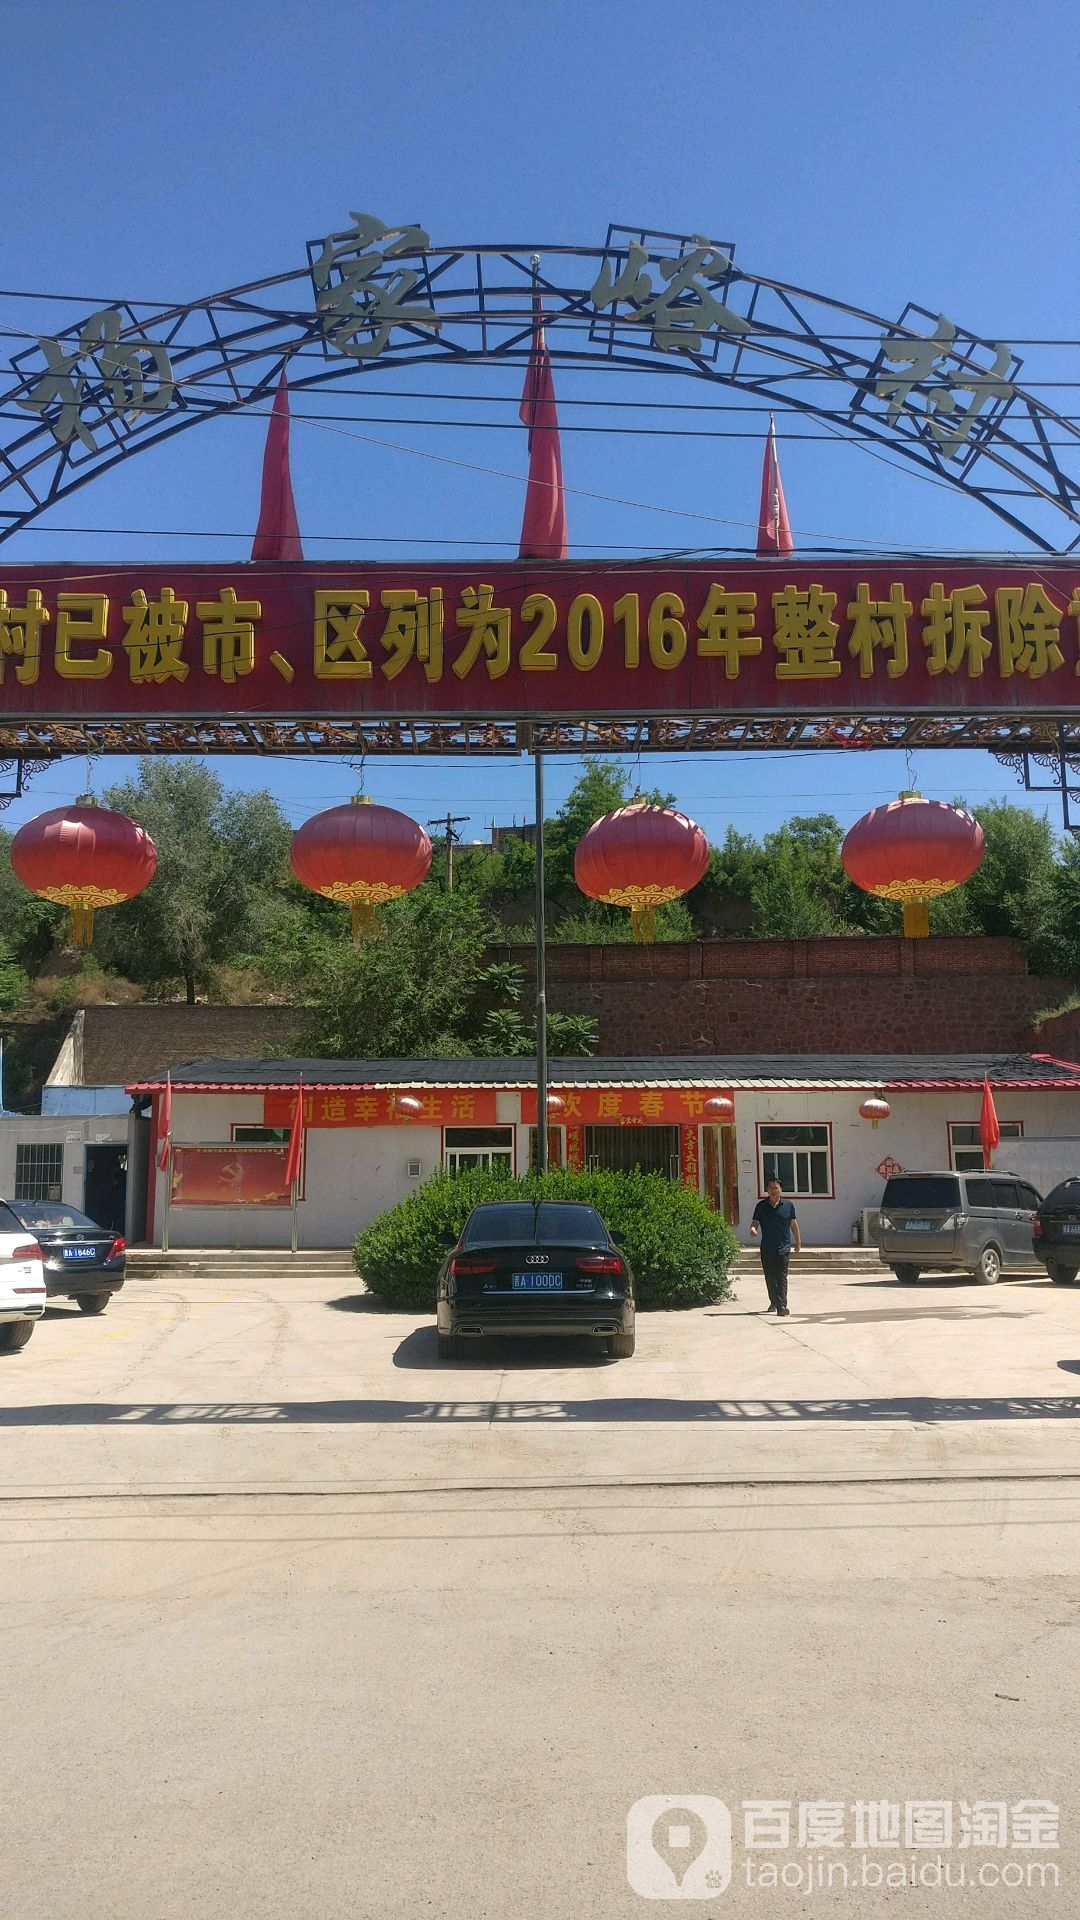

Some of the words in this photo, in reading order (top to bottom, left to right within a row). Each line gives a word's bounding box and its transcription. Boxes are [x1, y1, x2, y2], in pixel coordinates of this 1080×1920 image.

[0, 582, 1080, 684] 村已被市、区列为2016年整村拆除
